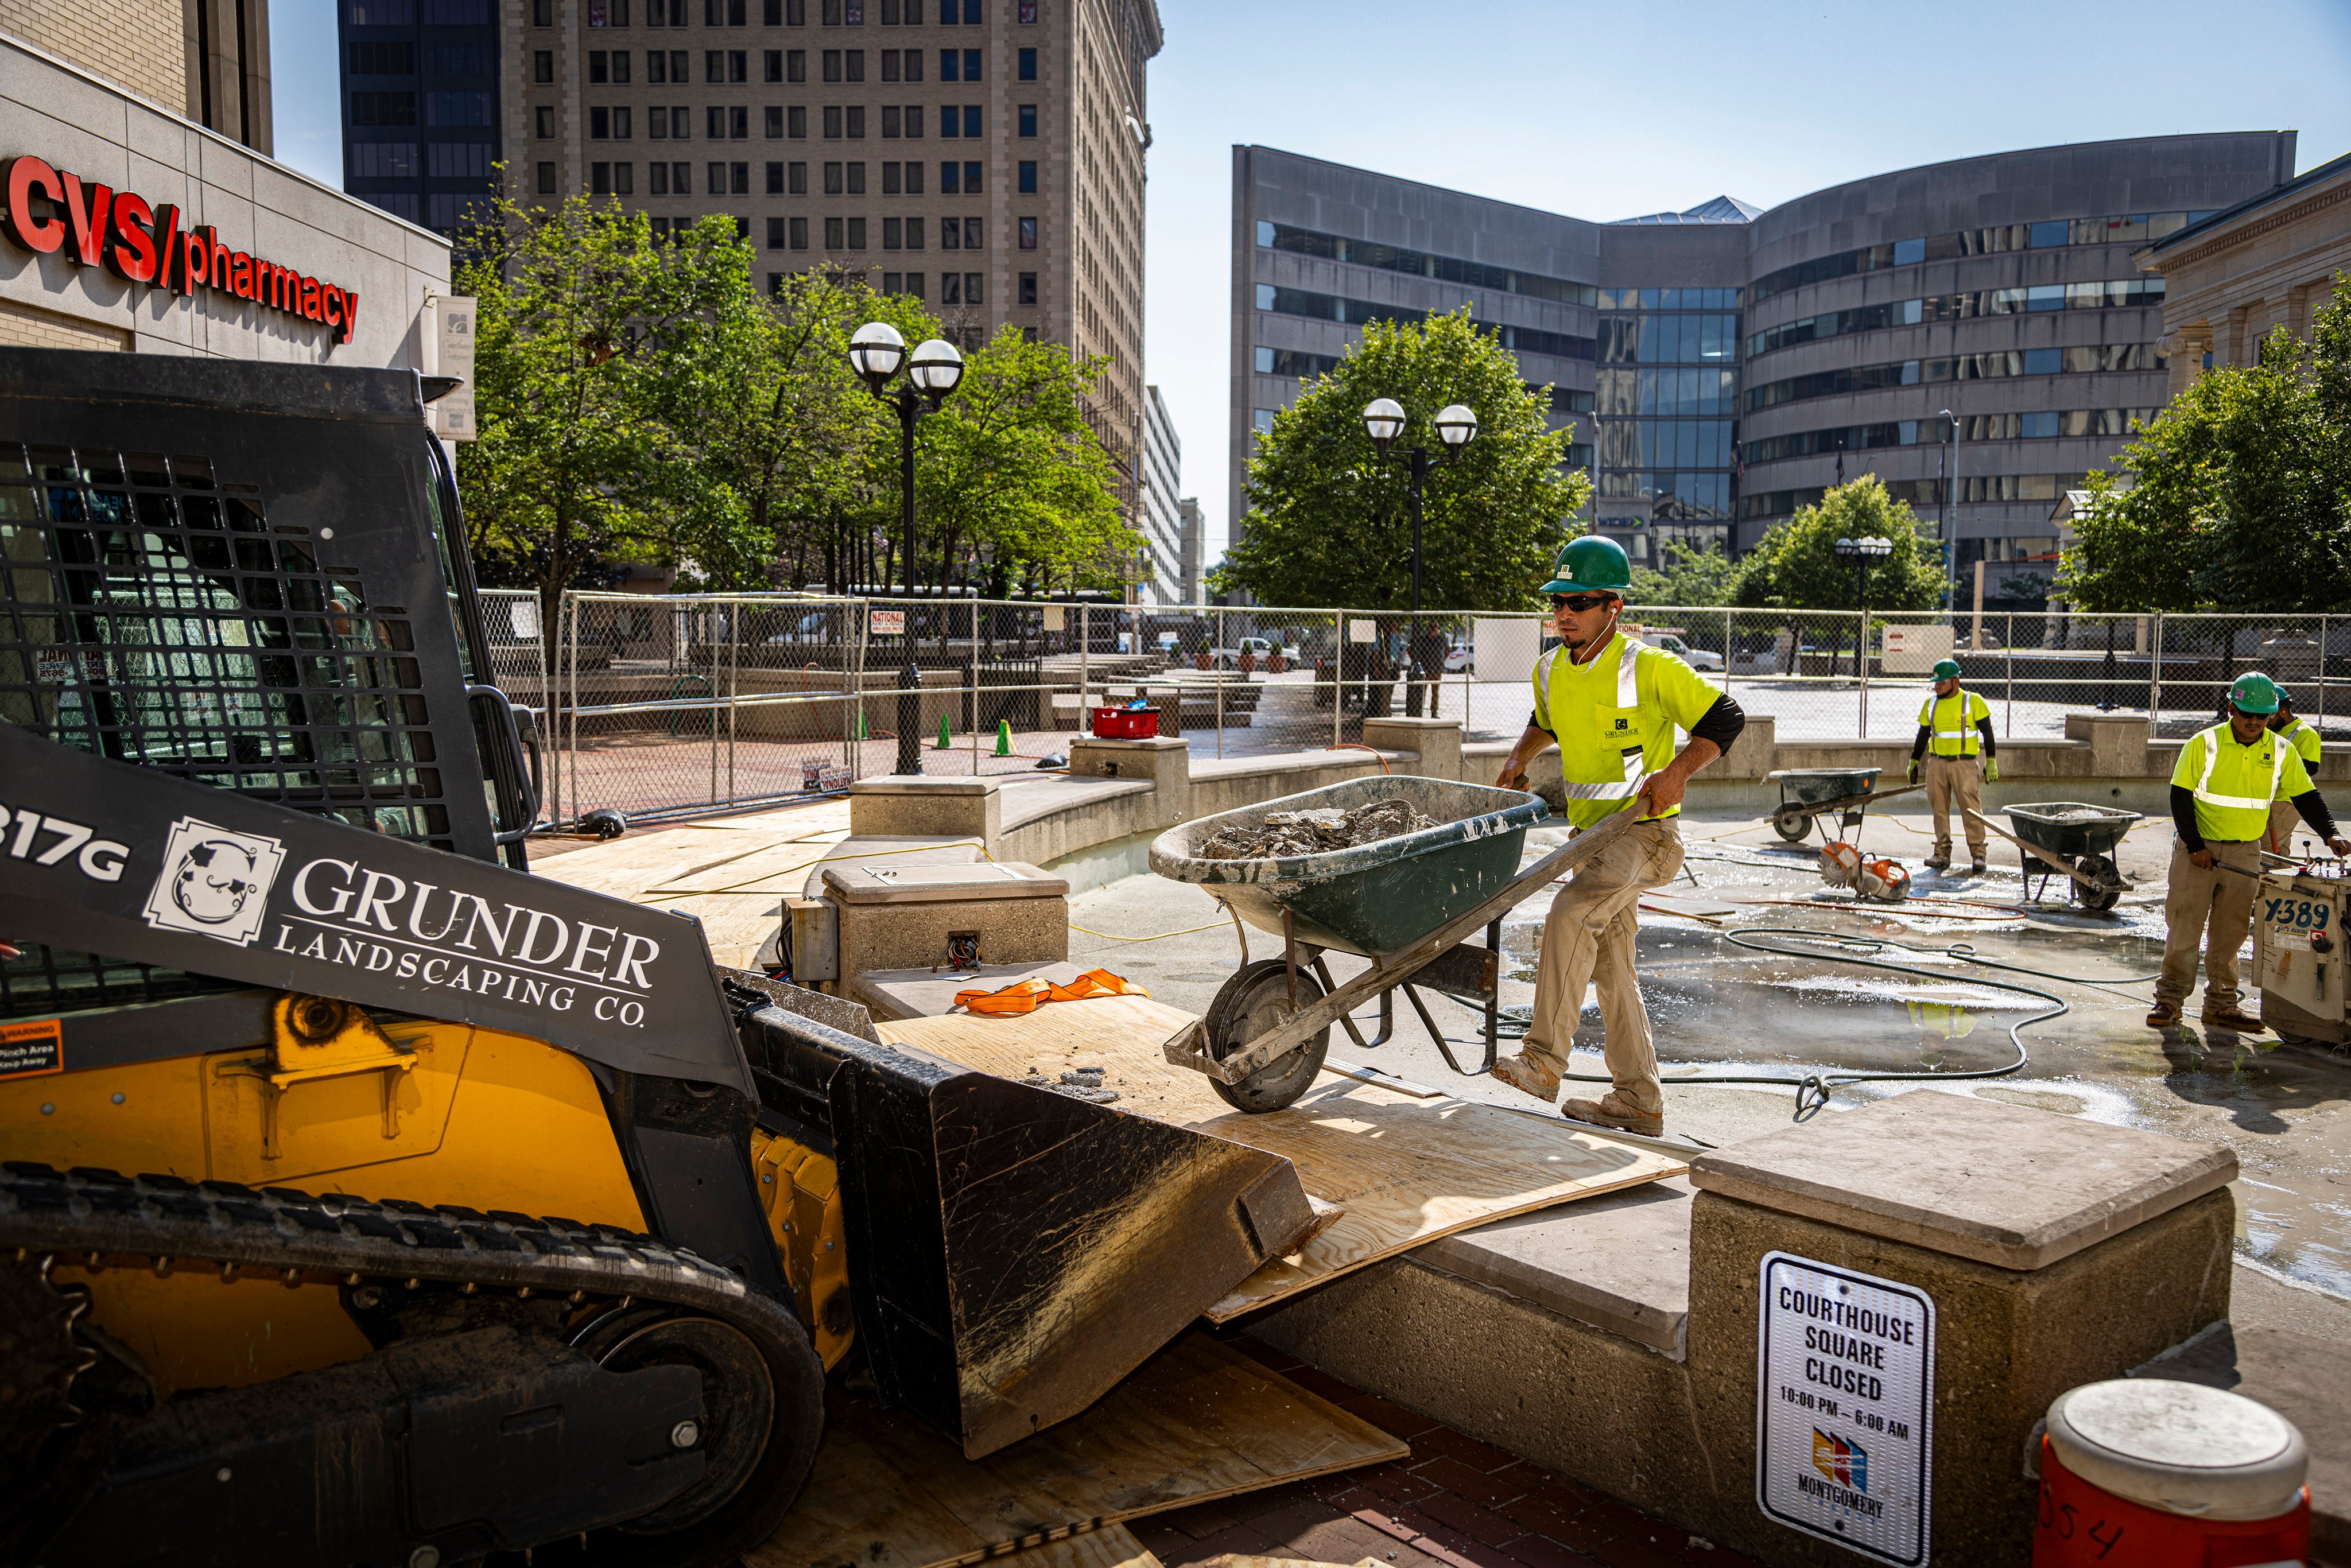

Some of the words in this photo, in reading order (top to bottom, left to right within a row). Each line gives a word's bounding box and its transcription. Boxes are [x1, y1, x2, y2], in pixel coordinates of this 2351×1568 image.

[872, 612, 903, 622] NATIONAL
[1605, 728, 1639, 736] GRUNDER
[821, 776, 851, 790] NATIONAL
[292, 858, 660, 988] GRUNDER
[273, 925, 576, 1011] LANDSCAPING
[595, 996, 645, 1028] CO.
[22, 1057, 47, 1066] Away
[29, 1045, 55, 1055] Area
[1780, 1287, 1914, 1346] COURTHOUSE
[1805, 1326, 1884, 1370] SQUARE
[1806, 1358, 1881, 1401] CLOSED
[1781, 1386, 1814, 1409] 10:00
[1819, 1397, 1838, 1417] PM
[1855, 1410, 1883, 1432] 6:00
[1888, 1420, 1908, 1441] AM
[1798, 1473, 1884, 1519] MONTGOMERY
